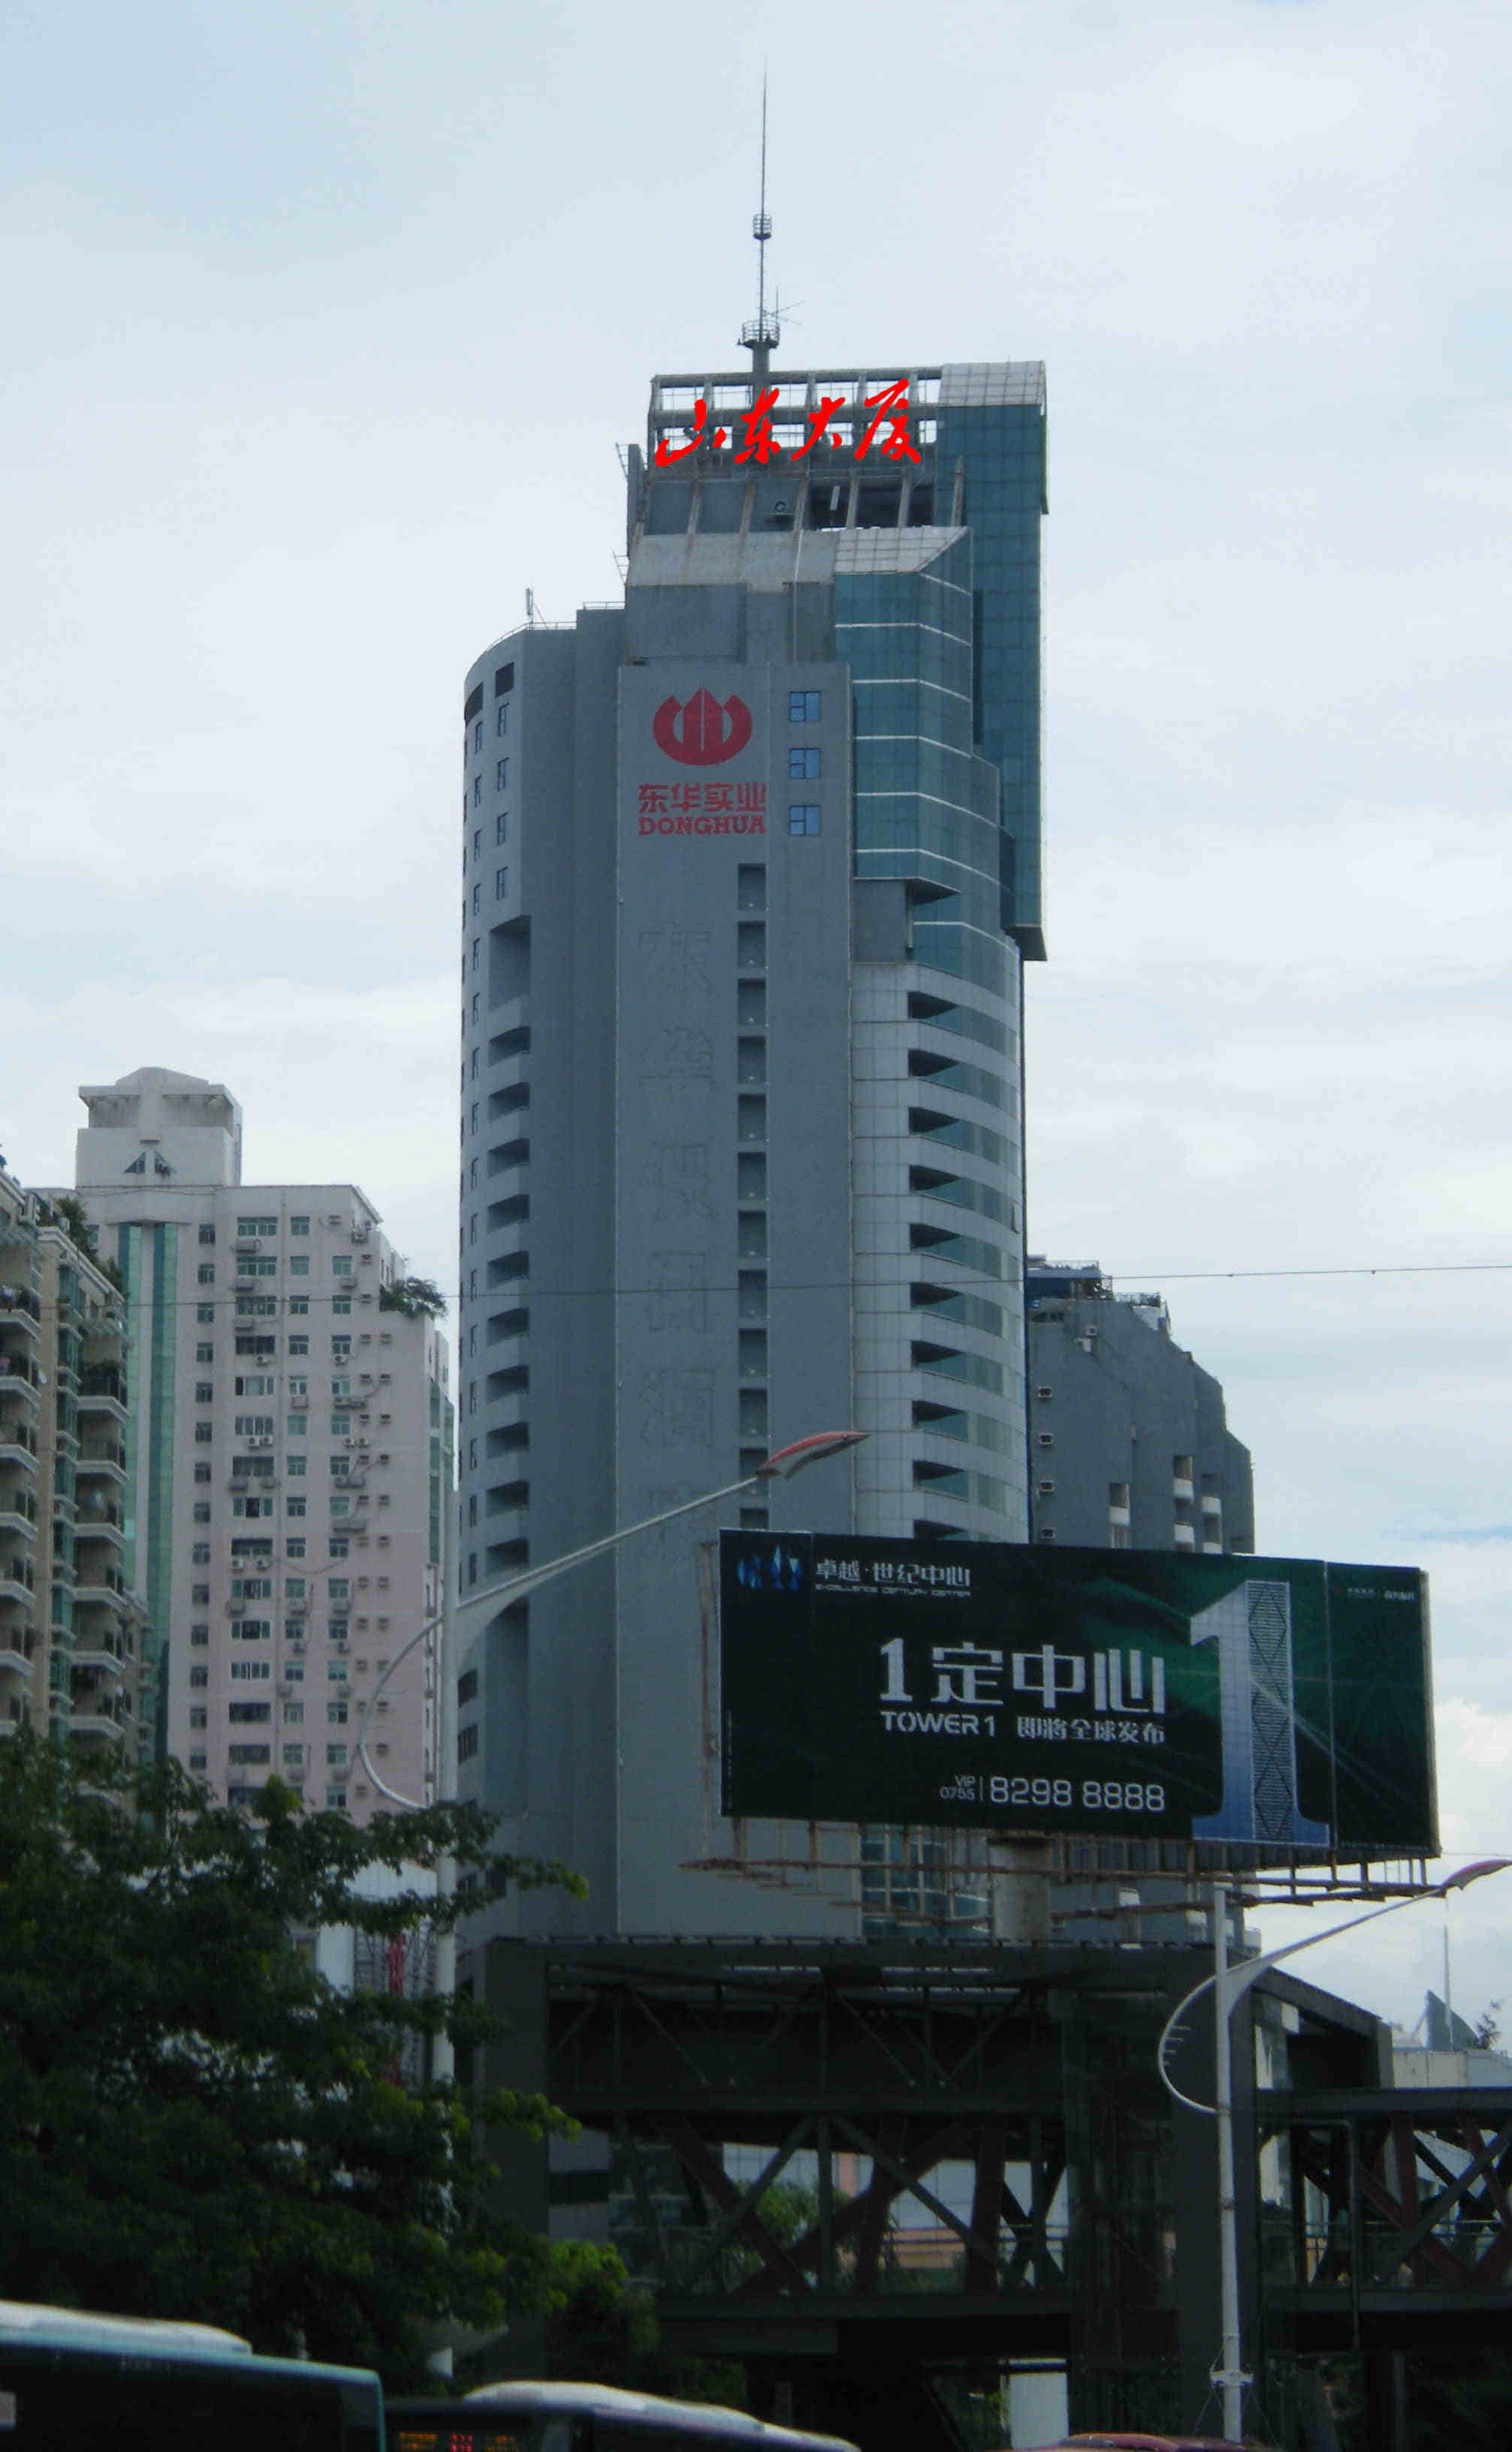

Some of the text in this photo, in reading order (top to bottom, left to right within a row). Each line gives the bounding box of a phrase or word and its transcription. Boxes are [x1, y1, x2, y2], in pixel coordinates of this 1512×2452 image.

[655, 379, 920, 467] 山东大厦
[638, 783, 767, 814] 东华实业
[638, 817, 766, 835] DONGHUA
[880, 1711, 997, 1737] TOWER 1
[1017, 1717, 1165, 1744] 即将全球发布
[940, 1786, 976, 1801] 0755
[955, 1775, 976, 1787] VIP
[990, 1777, 1166, 1811] 8298 8888
